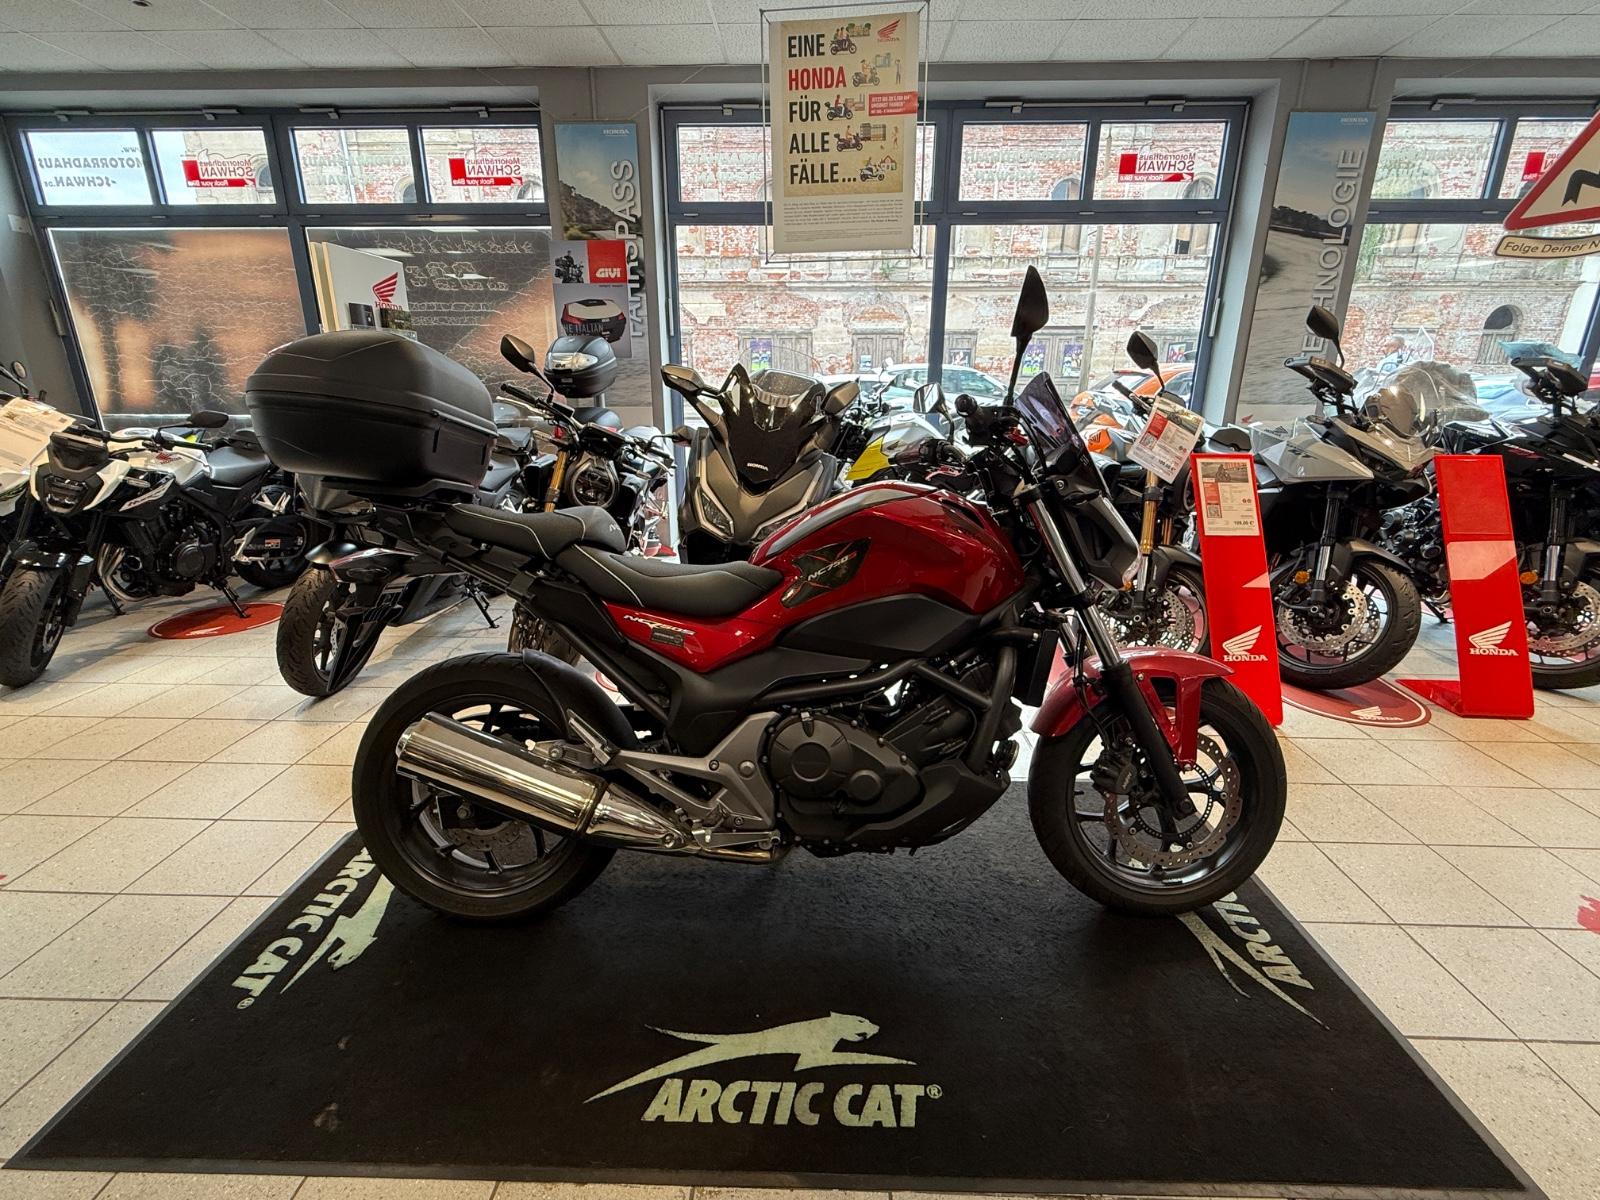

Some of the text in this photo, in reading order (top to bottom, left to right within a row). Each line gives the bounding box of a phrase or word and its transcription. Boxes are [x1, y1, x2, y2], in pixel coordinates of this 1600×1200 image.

[787, 34, 825, 58] EINE
[788, 66, 847, 91] HONDA
[789, 95, 821, 123] FÜR
[789, 131, 830, 154] ALLE
[790, 158, 857, 185] FÄLLE...
[1503, 241, 1539, 254] Folge
[1541, 240, 1588, 253] Deiner
[595, 267, 622, 278] GIVI
[746, 462, 769, 471] HONDA
[1223, 654, 1269, 662] HONDA
[1469, 647, 1520, 656] HONDA
[287, 846, 377, 933] ARCTIC
[640, 1077, 825, 1126] ARCTIC
